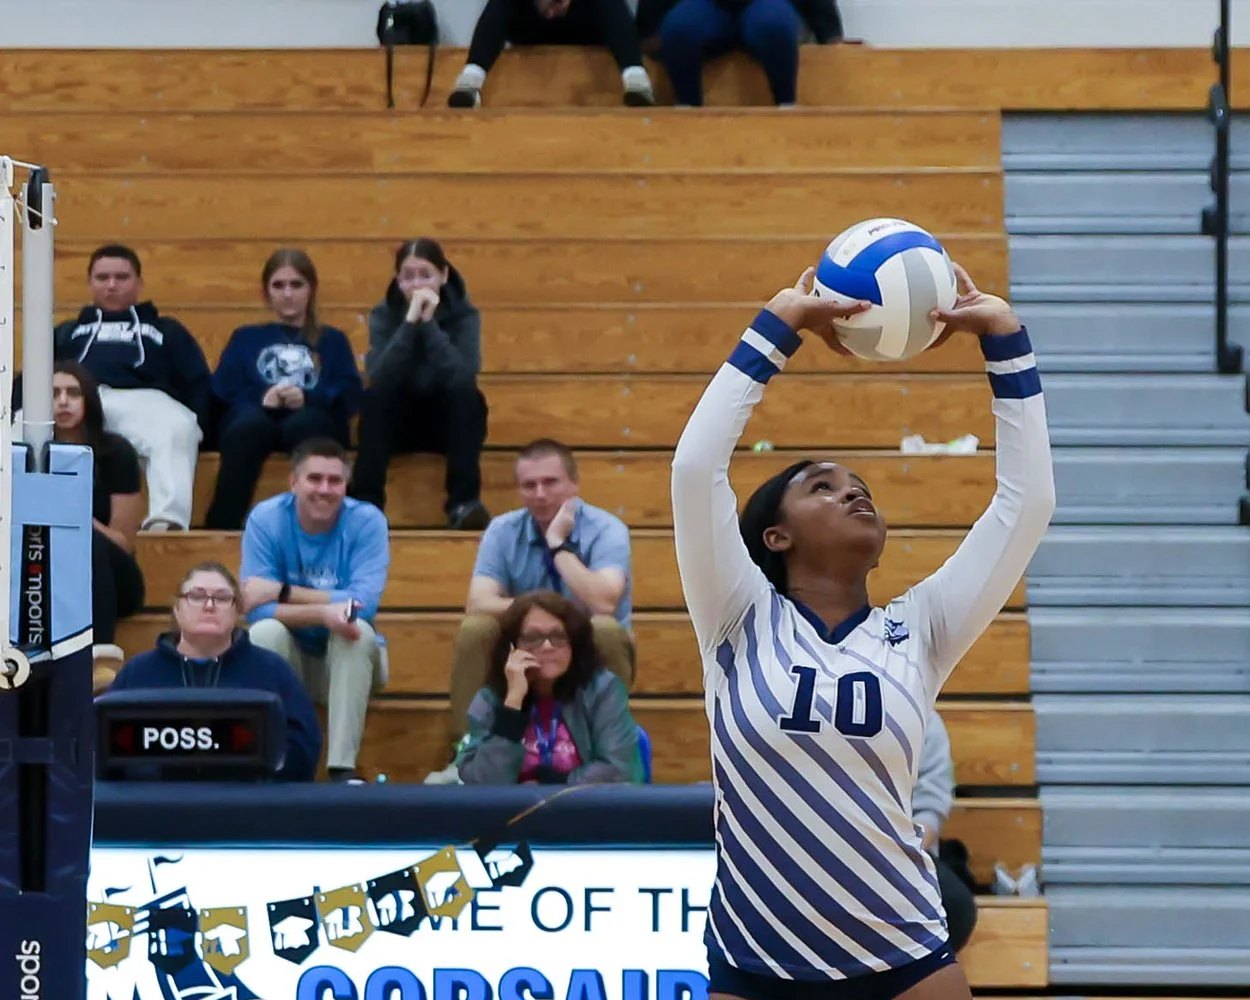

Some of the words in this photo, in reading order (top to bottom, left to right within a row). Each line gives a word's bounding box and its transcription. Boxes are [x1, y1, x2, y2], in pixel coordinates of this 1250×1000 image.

[780, 665, 882, 737] 10
[143, 727, 220, 750] POSS.
[530, 886, 615, 932] OF
